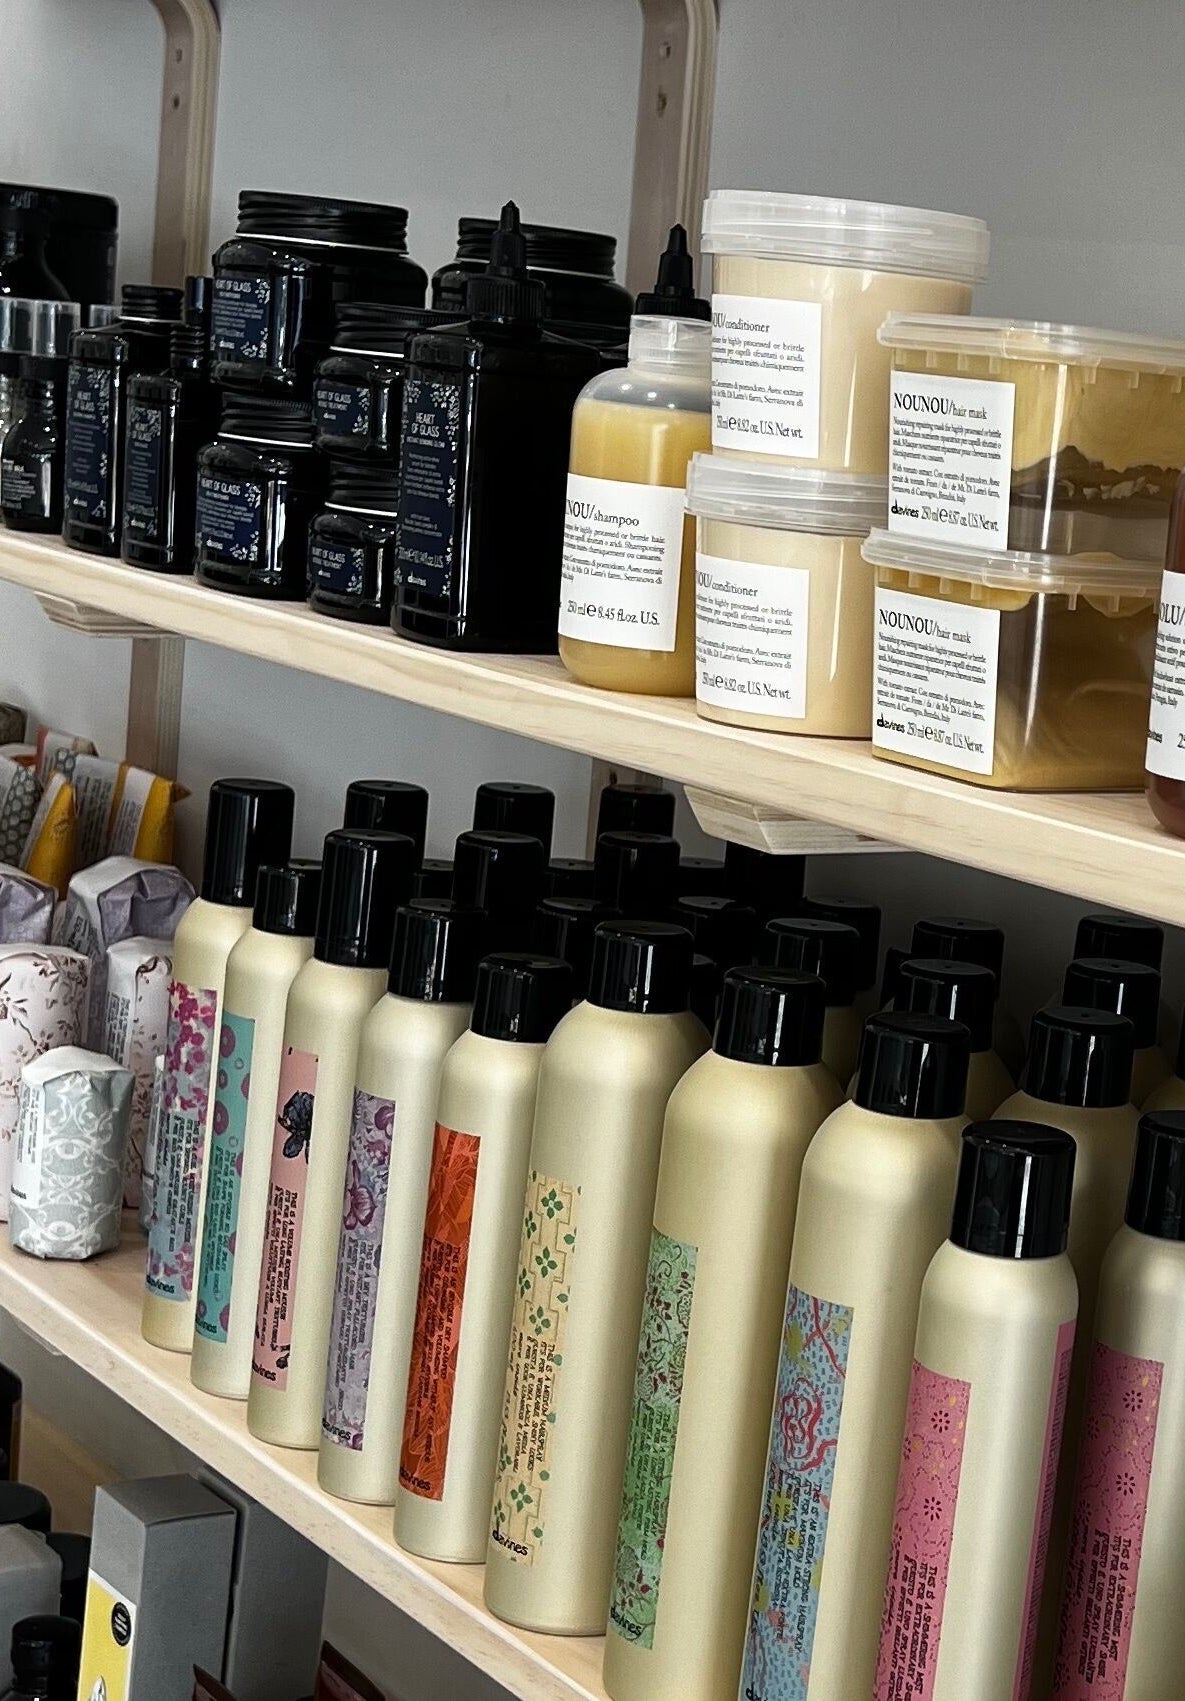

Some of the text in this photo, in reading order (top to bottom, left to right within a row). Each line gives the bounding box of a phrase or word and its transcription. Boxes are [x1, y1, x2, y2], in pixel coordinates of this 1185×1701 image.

[420, 424, 439, 437] GLASS
[891, 499, 919, 518] davines
[641, 610, 660, 626] U.S.
[879, 609, 950, 639] NOUNOU/hair
[877, 712, 905, 733] davines
[492, 1520, 528, 1556] davines
